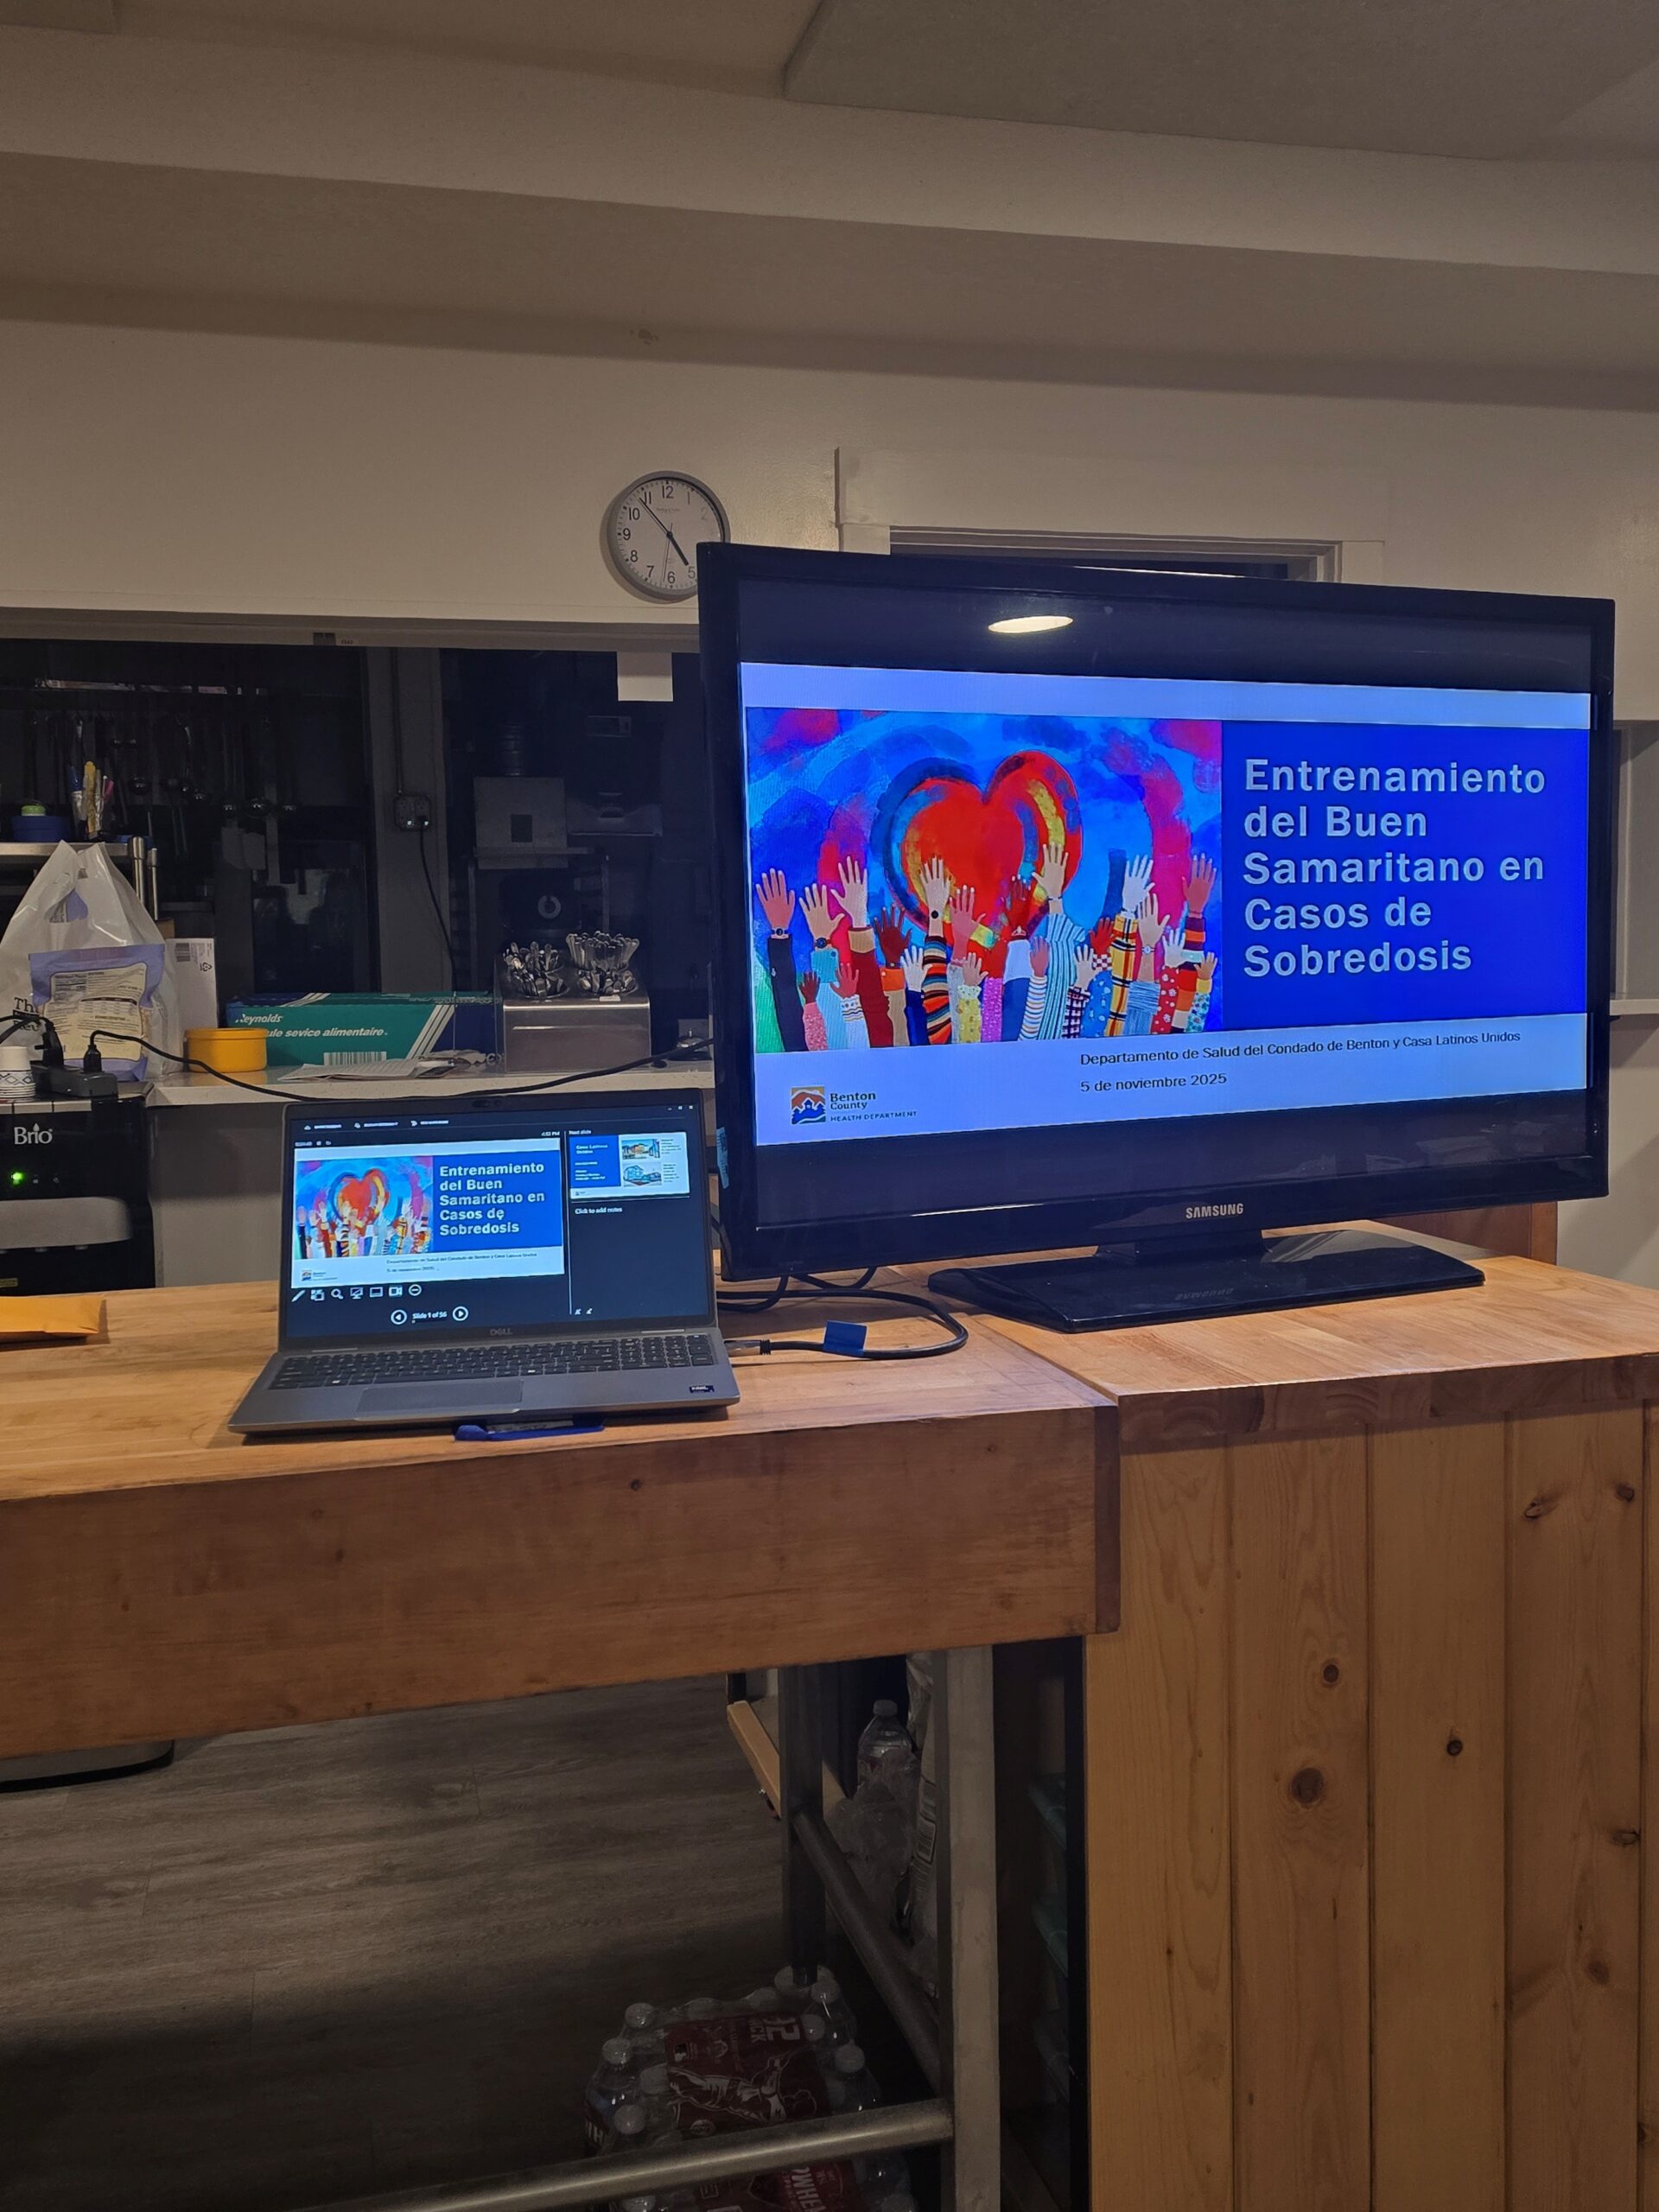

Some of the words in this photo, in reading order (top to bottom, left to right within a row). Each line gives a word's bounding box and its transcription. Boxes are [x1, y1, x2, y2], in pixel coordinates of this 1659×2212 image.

[644, 492, 652, 505] 11
[662, 486, 674, 499] 12
[687, 492, 690, 505] 1
[628, 507, 640, 520] 10
[623, 528, 631, 541] 9
[630, 550, 639, 563] 8
[646, 565, 654, 578] 7
[667, 571, 676, 583] 6
[688, 566, 696, 579] 5
[1244, 758, 1546, 794] Entrenamiento
[1243, 805, 1308, 838] del
[1325, 805, 1427, 837] Buen
[1243, 852, 1484, 885] Samaritano
[1499, 856, 1543, 880] en
[1243, 898, 1370, 931] Casos
[1384, 896, 1433, 926] de
[1243, 940, 1472, 978] Sobredosis
[285, 1027, 321, 1038] sevice
[322, 1027, 385, 1037] alimentaire
[1080, 1050, 1179, 1066] Departamento
[1182, 1048, 1198, 1059] de
[1203, 1045, 1240, 1058] Salud
[1243, 1044, 1263, 1056] del
[1268, 1040, 1324, 1055] Condado
[1327, 1039, 1343, 1052] de
[1346, 1038, 1390, 1051] Benton
[1393, 1037, 1401, 1049] y
[1402, 1035, 1432, 1047] Casa
[1436, 1033, 1478, 1046] Latinos
[1481, 1031, 1521, 1043] Unidos
[1080, 1081, 1090, 1092] 5
[1094, 1079, 1111, 1091] de
[1116, 1076, 1186, 1090] noviembre
[1191, 1072, 1227, 1086] 2025
[830, 1091, 876, 1103] Benton
[830, 1101, 868, 1111] County
[830, 1114, 862, 1122] HEALTH
[864, 1111, 917, 1121] DEPARTMENT
[14, 1122, 53, 1145] Brio
[439, 1162, 544, 1177] Entrenamiento
[439, 1180, 461, 1191] del
[467, 1179, 502, 1190] Buen
[439, 1193, 523, 1206] Samaritano
[527, 1192, 544, 1202] en
[439, 1210, 483, 1221] Casos
[486, 1207, 505, 1219] de
[1185, 1203, 1244, 1219] SAMSUNG
[439, 1222, 519, 1236] Sobredosis
